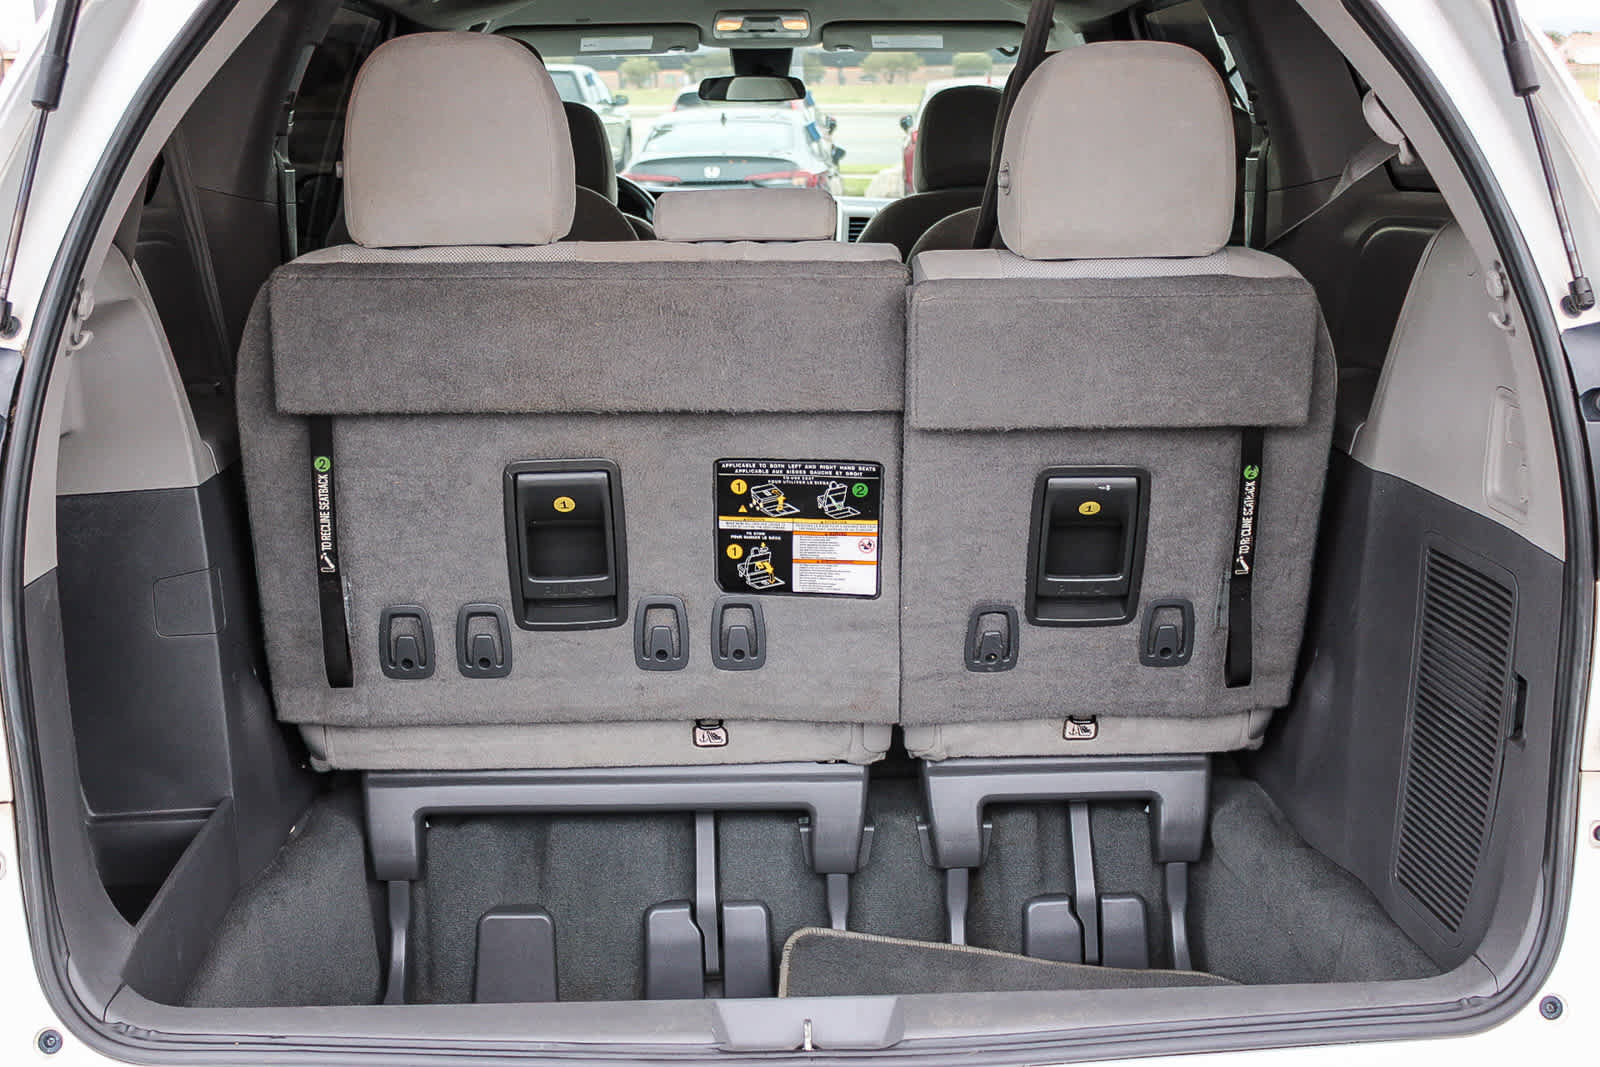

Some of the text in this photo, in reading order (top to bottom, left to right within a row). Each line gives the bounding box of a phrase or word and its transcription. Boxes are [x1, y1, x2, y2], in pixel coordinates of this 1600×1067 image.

[318, 474, 332, 551] TO RECLINE SEATBACK
